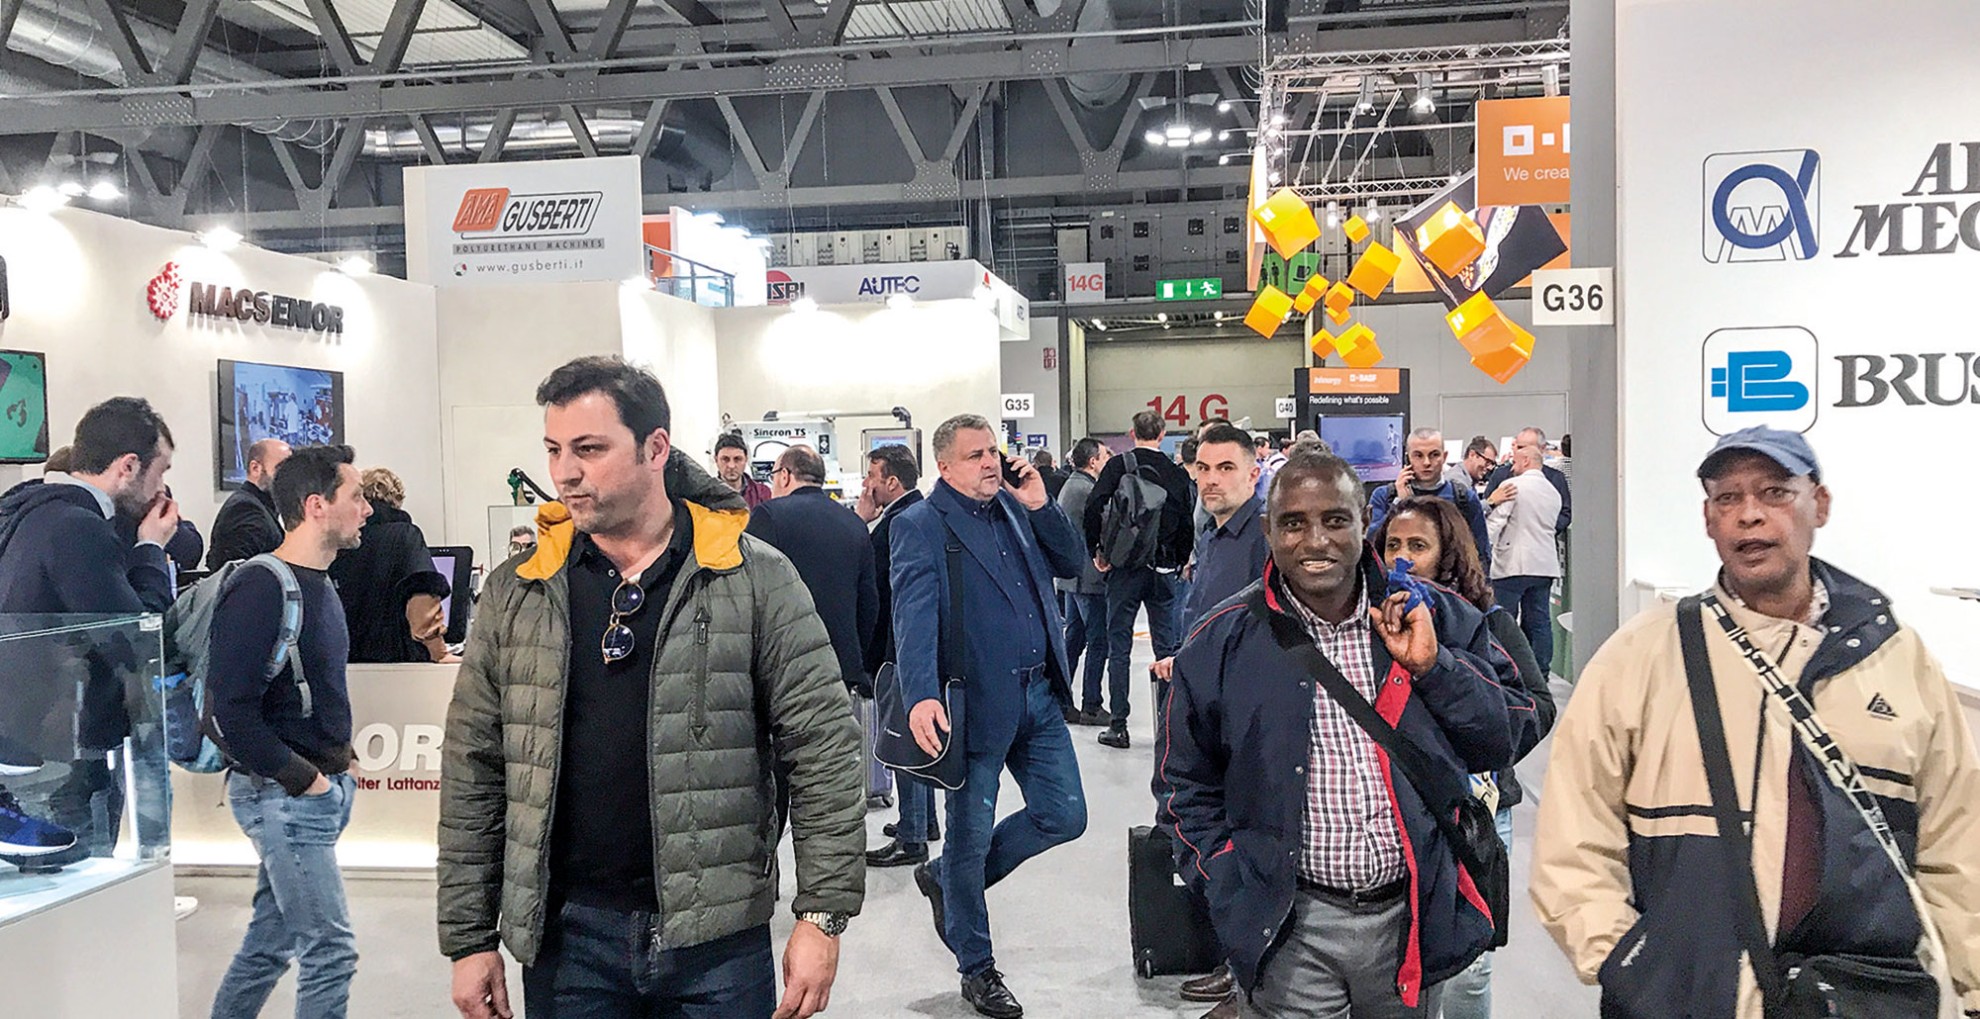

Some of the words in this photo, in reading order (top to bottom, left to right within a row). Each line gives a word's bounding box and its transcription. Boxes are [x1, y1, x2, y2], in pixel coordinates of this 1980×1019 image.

[1503, 167, 1529, 181] We
[1534, 167, 1570, 179] crea
[457, 192, 500, 226] AMA
[502, 198, 594, 232] GUSBERTI
[456, 243, 537, 253] POLYURETHANE
[545, 240, 602, 250] MACHINES
[476, 259, 584, 274] www.gusberti.it
[858, 275, 920, 295] AUTEC
[1068, 274, 1103, 291] 14G
[1543, 284, 1604, 312] G36
[1833, 352, 1980, 407] BRU
[1005, 398, 1030, 411] G35
[1279, 402, 1294, 413] G40
[1309, 396, 1342, 406] Redefining
[1344, 395, 1363, 404] what's
[1364, 395, 1390, 405] possible
[1147, 395, 1190, 426] 14
[1199, 394, 1229, 422] G
[753, 428, 792, 437] Sincron
[795, 428, 806, 436] TS
[354, 723, 445, 772] OR
[387, 777, 441, 790] Lattanz
